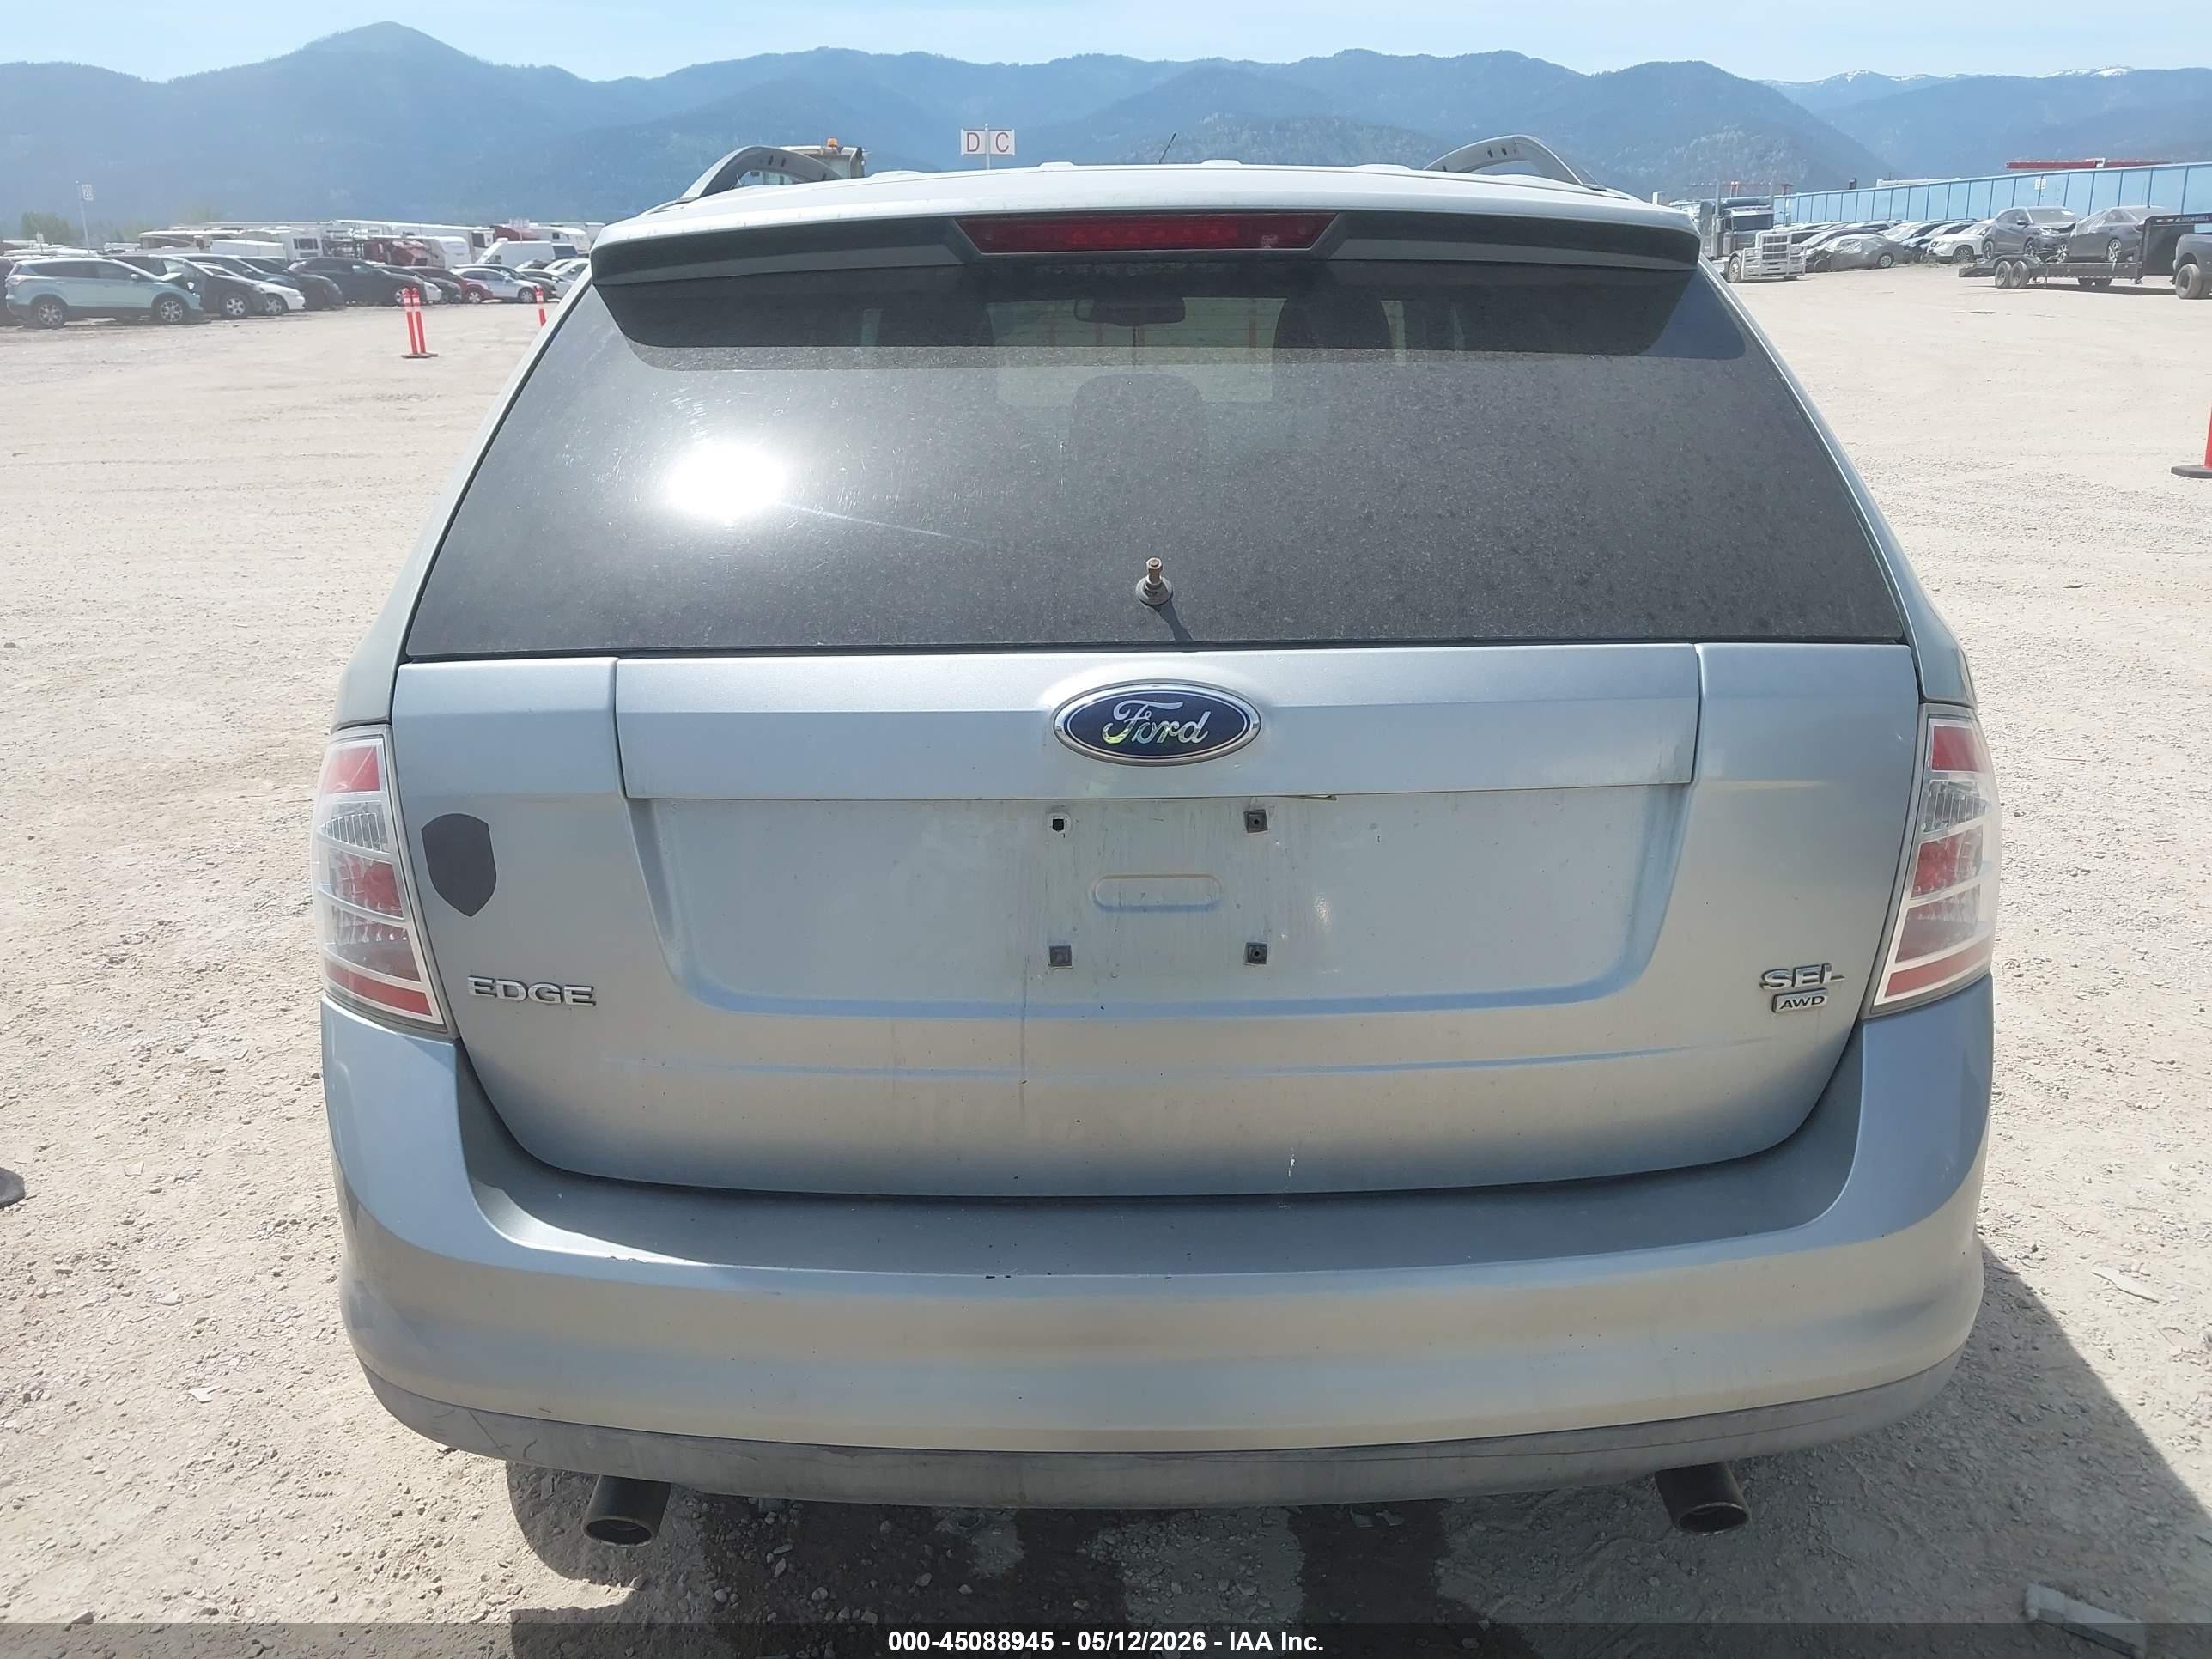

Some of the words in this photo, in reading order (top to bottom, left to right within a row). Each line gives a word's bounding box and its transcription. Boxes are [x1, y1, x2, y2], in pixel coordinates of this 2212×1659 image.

[966, 131, 980, 152] D
[995, 131, 1009, 153] C
[1103, 700, 1211, 745] Ford
[1759, 963, 1845, 990] SEL
[467, 975, 597, 1006] EDGE
[1780, 995, 1825, 1009] AWD
